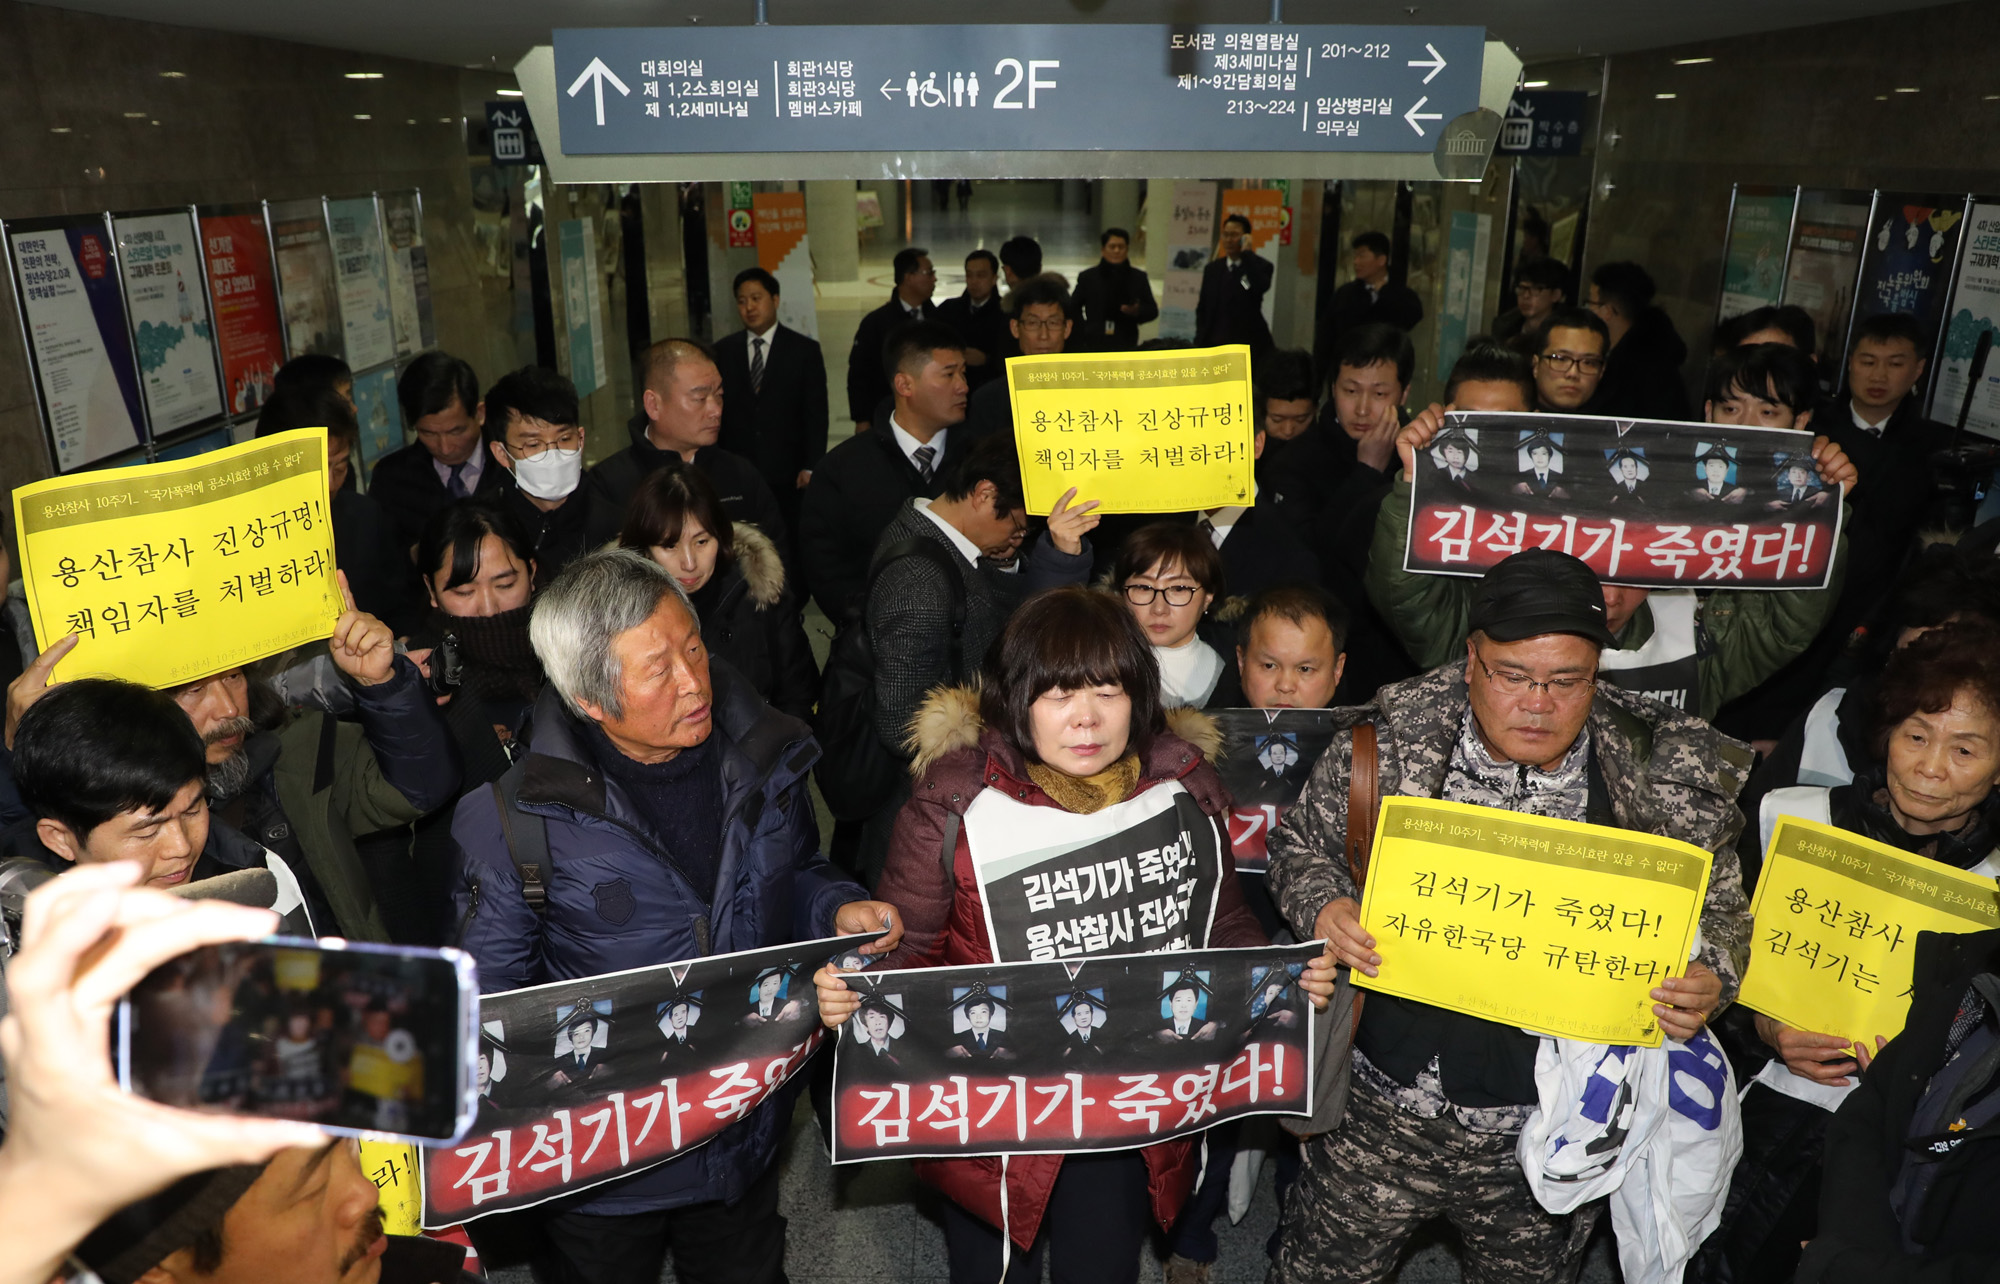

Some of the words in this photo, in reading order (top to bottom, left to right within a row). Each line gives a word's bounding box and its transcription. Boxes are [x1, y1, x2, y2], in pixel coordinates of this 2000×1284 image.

[1170, 33, 1216, 50] 도서관
[1224, 32, 1299, 51] 의원열람실
[1321, 43, 1390, 59] 201~212
[641, 60, 703, 77] 대회의실
[787, 60, 853, 77] 회관1식당
[1214, 53, 1298, 71] 제3세미나실
[643, 81, 659, 98] 제
[668, 79, 759, 98] 1,2소회의실
[787, 80, 856, 98] 회관3식당
[993, 58, 1060, 109] 2F
[1177, 73, 1297, 91] 제1~9간담회의실
[645, 102, 660, 118] 제
[668, 101, 749, 118] 1,2세미나실
[788, 100, 862, 118] 멤버스카페
[1226, 100, 1296, 115] 213~224
[1316, 97, 1392, 116] 임상병리실
[1316, 120, 1360, 137] 의무실
[1027, 371, 1058, 383] 용산참사
[1137, 368, 1178, 380] 공소시효란
[1181, 367, 1198, 379] 있을
[1201, 367, 1210, 377] 수
[1030, 409, 1123, 433] 용산참사
[1137, 402, 1243, 432] 진상규명!
[1034, 447, 1124, 471] 책임자를
[1139, 440, 1246, 469] 처벌하라!
[42, 498, 90, 519] 용산참사
[207, 467, 252, 489] 공소시효란
[253, 463, 270, 478] 있을
[272, 459, 283, 473] 수
[51, 537, 195, 589] 용산참사
[212, 499, 323, 557] 진상규명!
[1428, 504, 1633, 578] 김석기가
[1644, 523, 1816, 580] 죽였다!
[66, 588, 201, 640] 책임자를
[219, 548, 333, 604] 처벌하라!
[1402, 817, 1445, 836] 용산참사
[1554, 842, 1608, 864] 공소시효란
[1613, 852, 1635, 867] 있을
[1639, 856, 1651, 869] 수
[1022, 856, 1134, 914] 김석기가
[1796, 840, 1838, 861] 용산참사
[1942, 889, 1998, 917] 공소시효란
[1410, 870, 1536, 918] 김석기가
[1554, 896, 1663, 938] 죽였다!
[1025, 907, 1134, 962] 용산참사
[1785, 888, 1905, 953] 용산참사
[1382, 912, 1526, 962] 자유한국당
[1543, 943, 1671, 985] 규탄한다!
[1764, 928, 1880, 994] 김석기는
[858, 1072, 1095, 1147] 김석기가
[1108, 1043, 1286, 1134] 죽였다!
[453, 1078, 691, 1206] 김석기가
